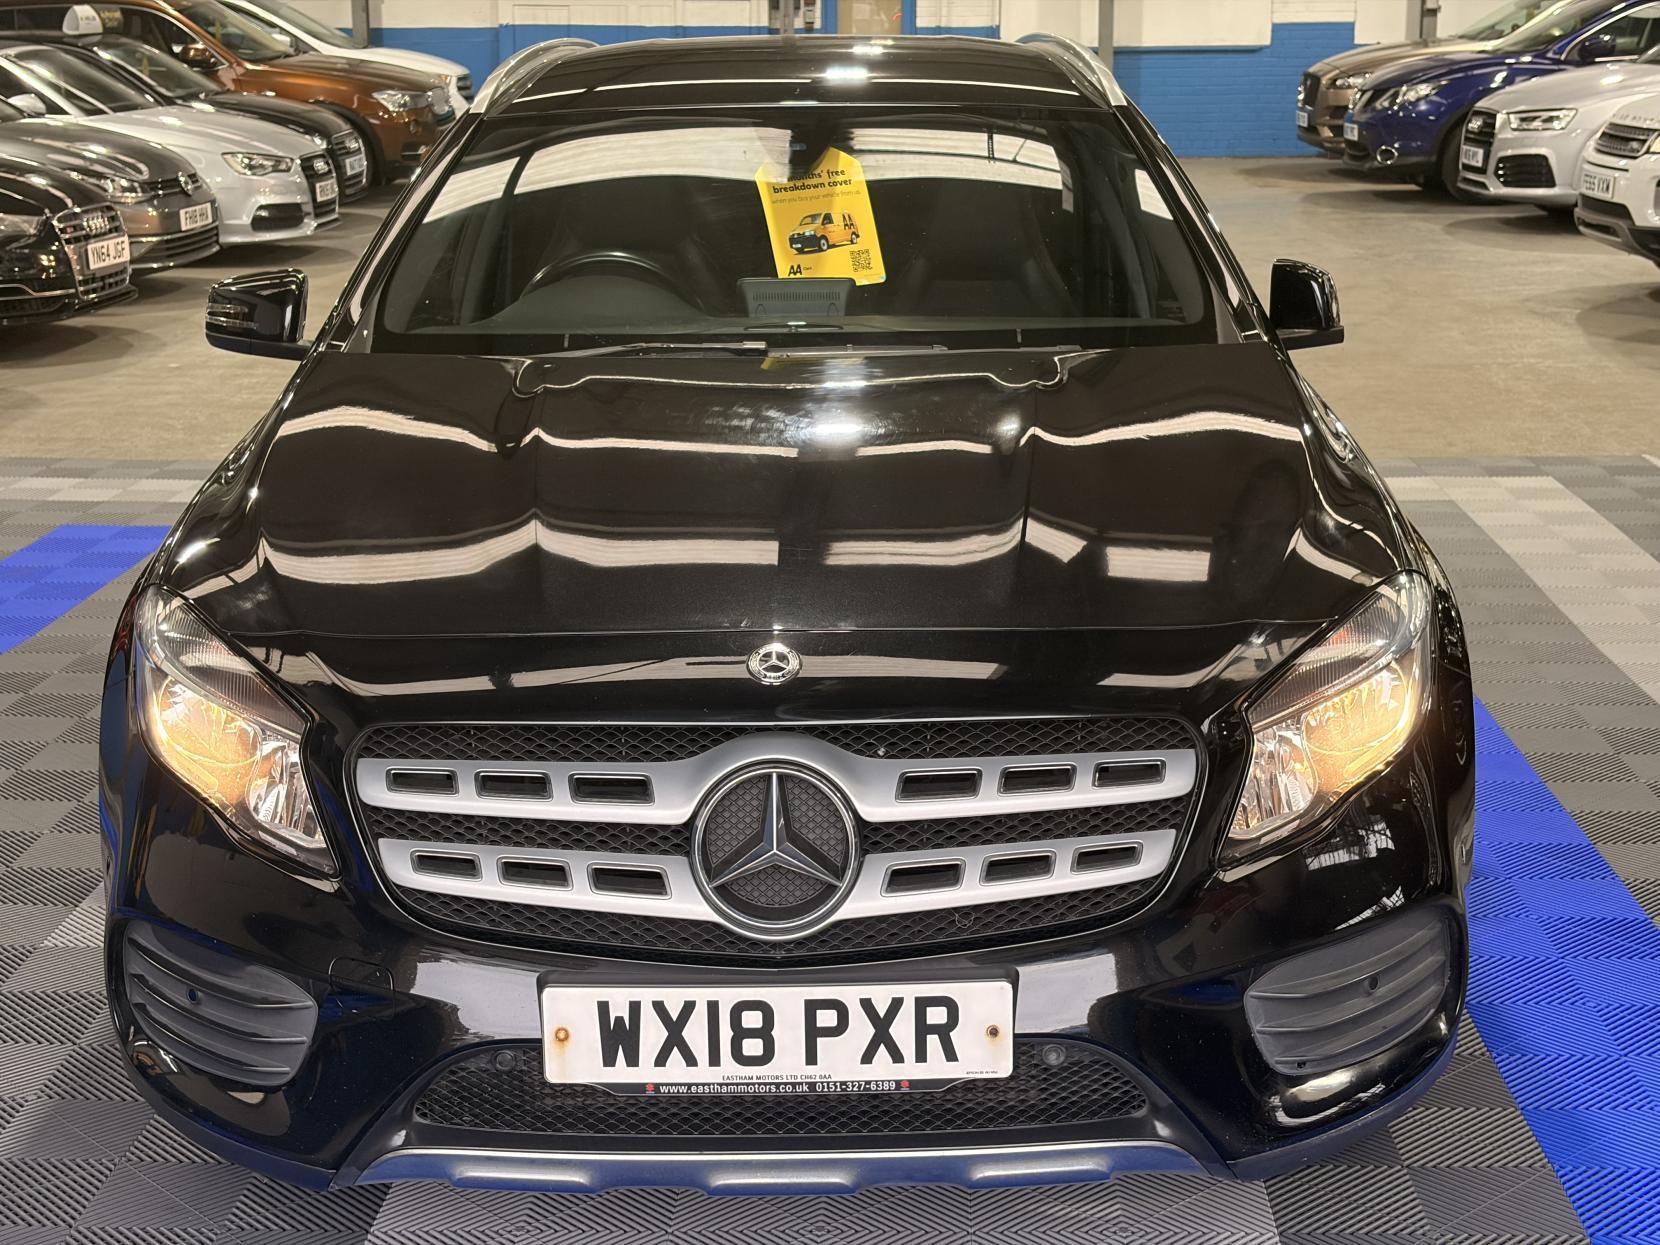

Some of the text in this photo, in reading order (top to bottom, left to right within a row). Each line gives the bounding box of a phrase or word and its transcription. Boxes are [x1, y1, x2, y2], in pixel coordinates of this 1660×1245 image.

[826, 169, 846, 180] free
[772, 179, 852, 194] breakdown cover
[842, 213, 855, 231] AA
[91, 240, 126, 265] YN64 JGF
[788, 264, 803, 277] AA
[597, 995, 960, 1067] WX18 PXR
[660, 1080, 896, 1094] www.easthammotors.co.uk 0151-327-6389
